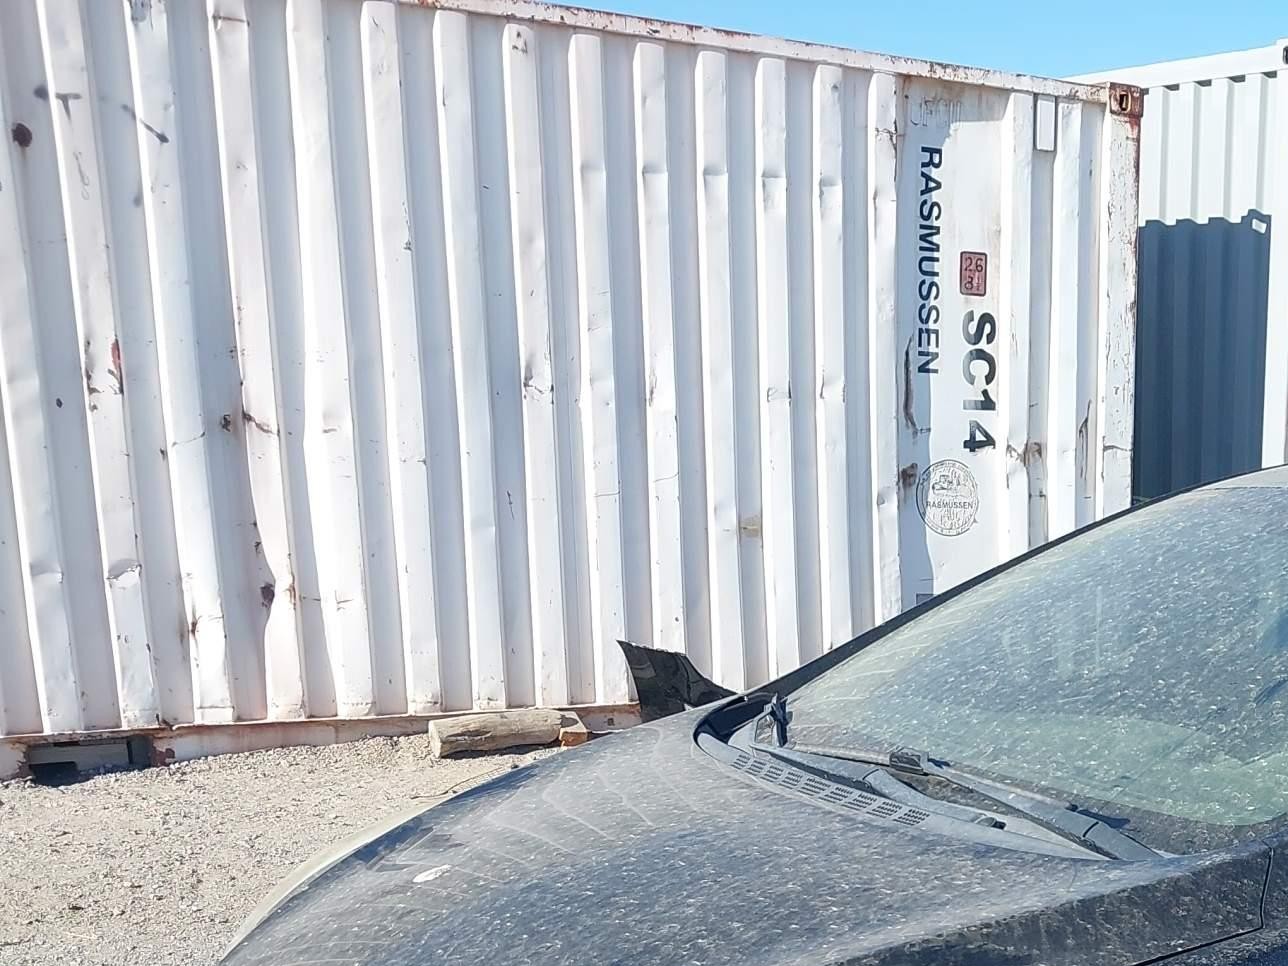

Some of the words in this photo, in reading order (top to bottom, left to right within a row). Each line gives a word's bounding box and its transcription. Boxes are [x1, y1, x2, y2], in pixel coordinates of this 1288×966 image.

[918, 146, 942, 373] RASMUSSEN
[962, 309, 996, 452] SC14
[926, 500, 973, 509] RASMUSSEN
